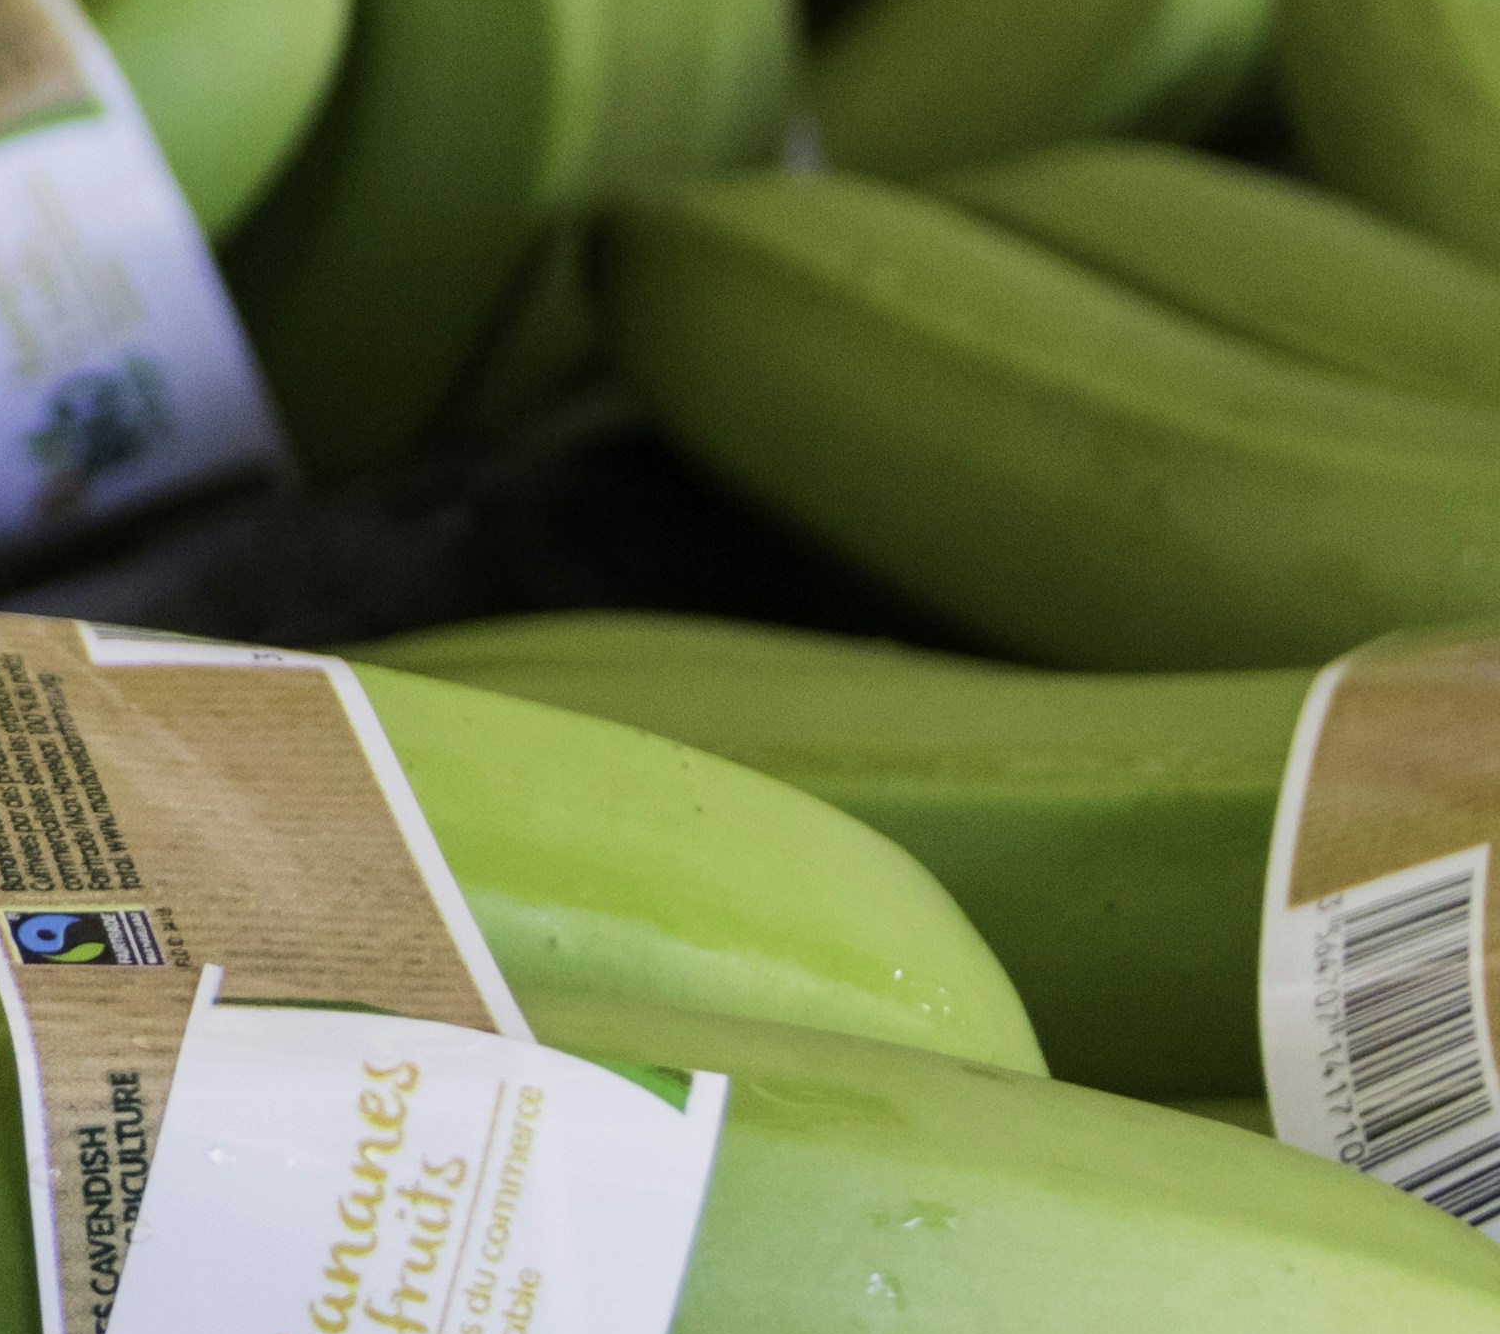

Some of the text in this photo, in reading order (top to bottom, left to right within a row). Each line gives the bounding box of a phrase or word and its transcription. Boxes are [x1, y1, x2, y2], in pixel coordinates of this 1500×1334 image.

[78, 1125, 121, 1296] CAVENDISH
[463, 1267, 498, 1317] du
[481, 1084, 545, 1265] commerce
